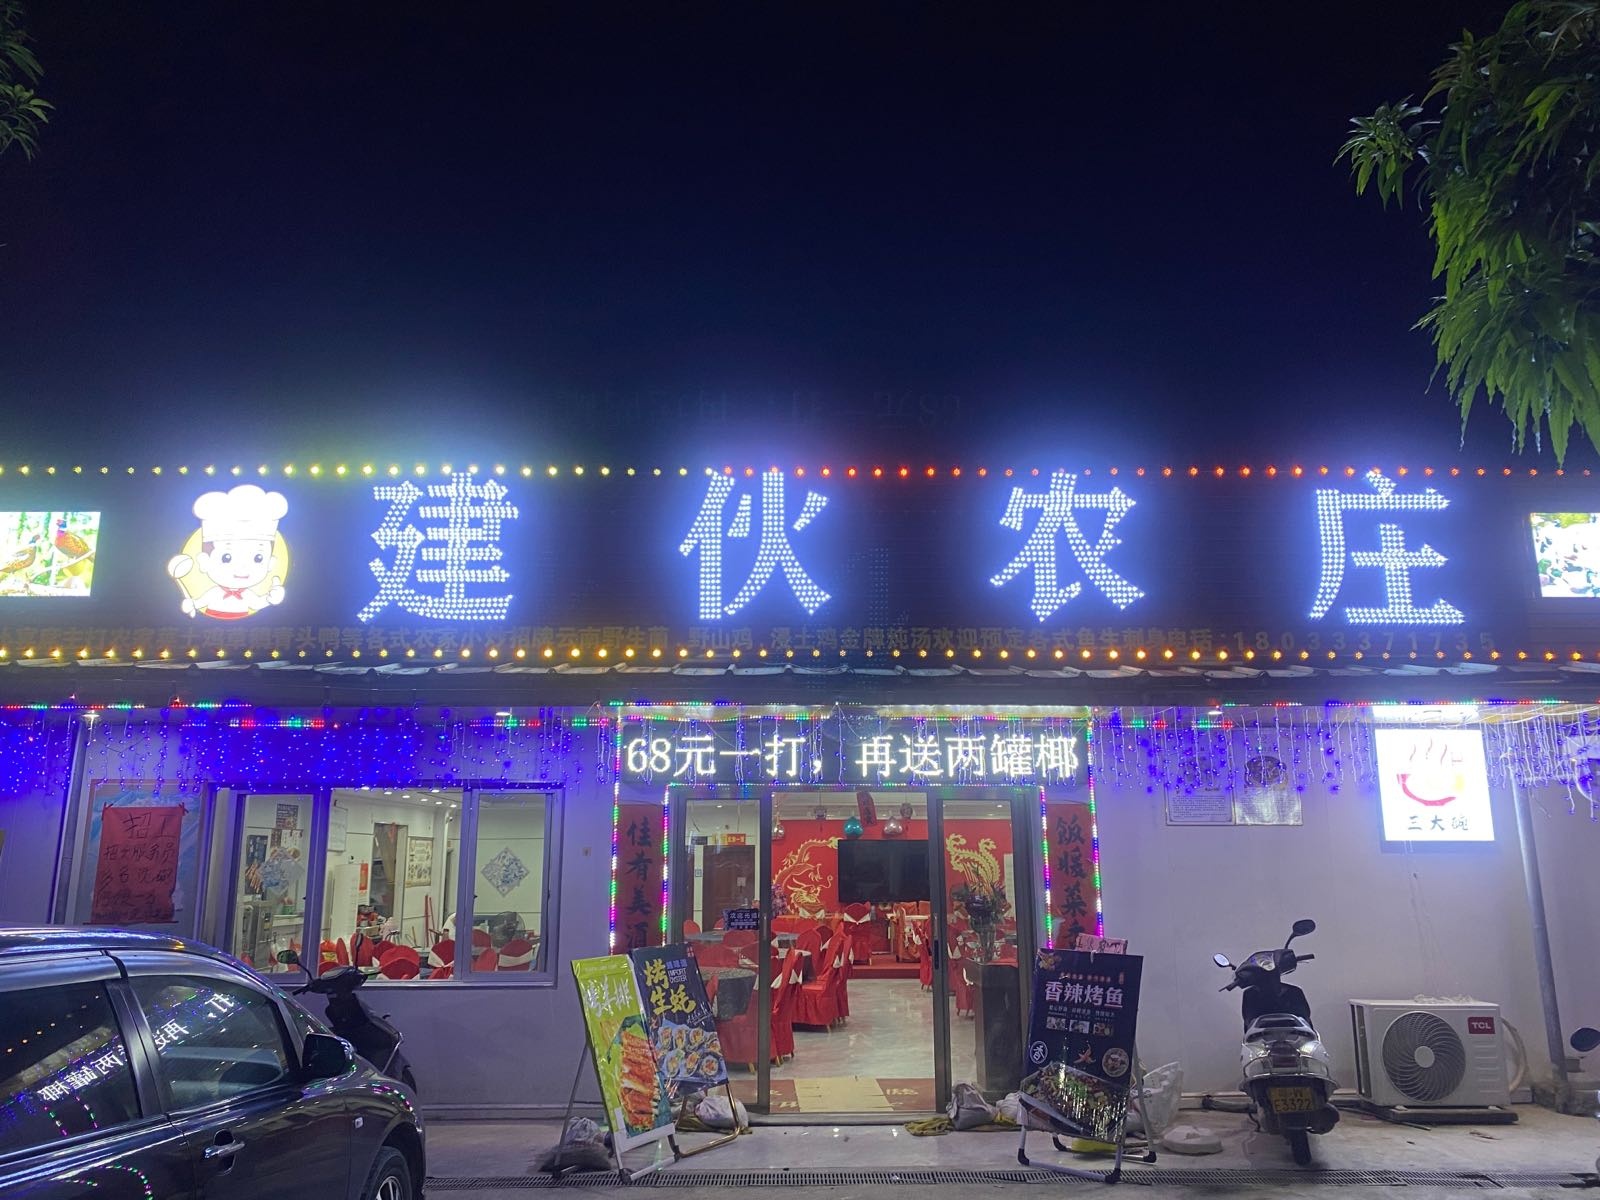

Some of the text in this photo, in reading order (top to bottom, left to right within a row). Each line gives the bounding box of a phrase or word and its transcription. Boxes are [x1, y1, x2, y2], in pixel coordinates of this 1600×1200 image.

[356, 470, 1467, 624] 建伙农庄
[123, 812, 178, 839] 招工
[1407, 815, 1470, 831] 三大碗
[644, 958, 671, 990] 烤
[649, 984, 697, 1016] 生蚝
[1045, 981, 1124, 1009] 香辣烤鱼
[1471, 1022, 1492, 1030] TCL
